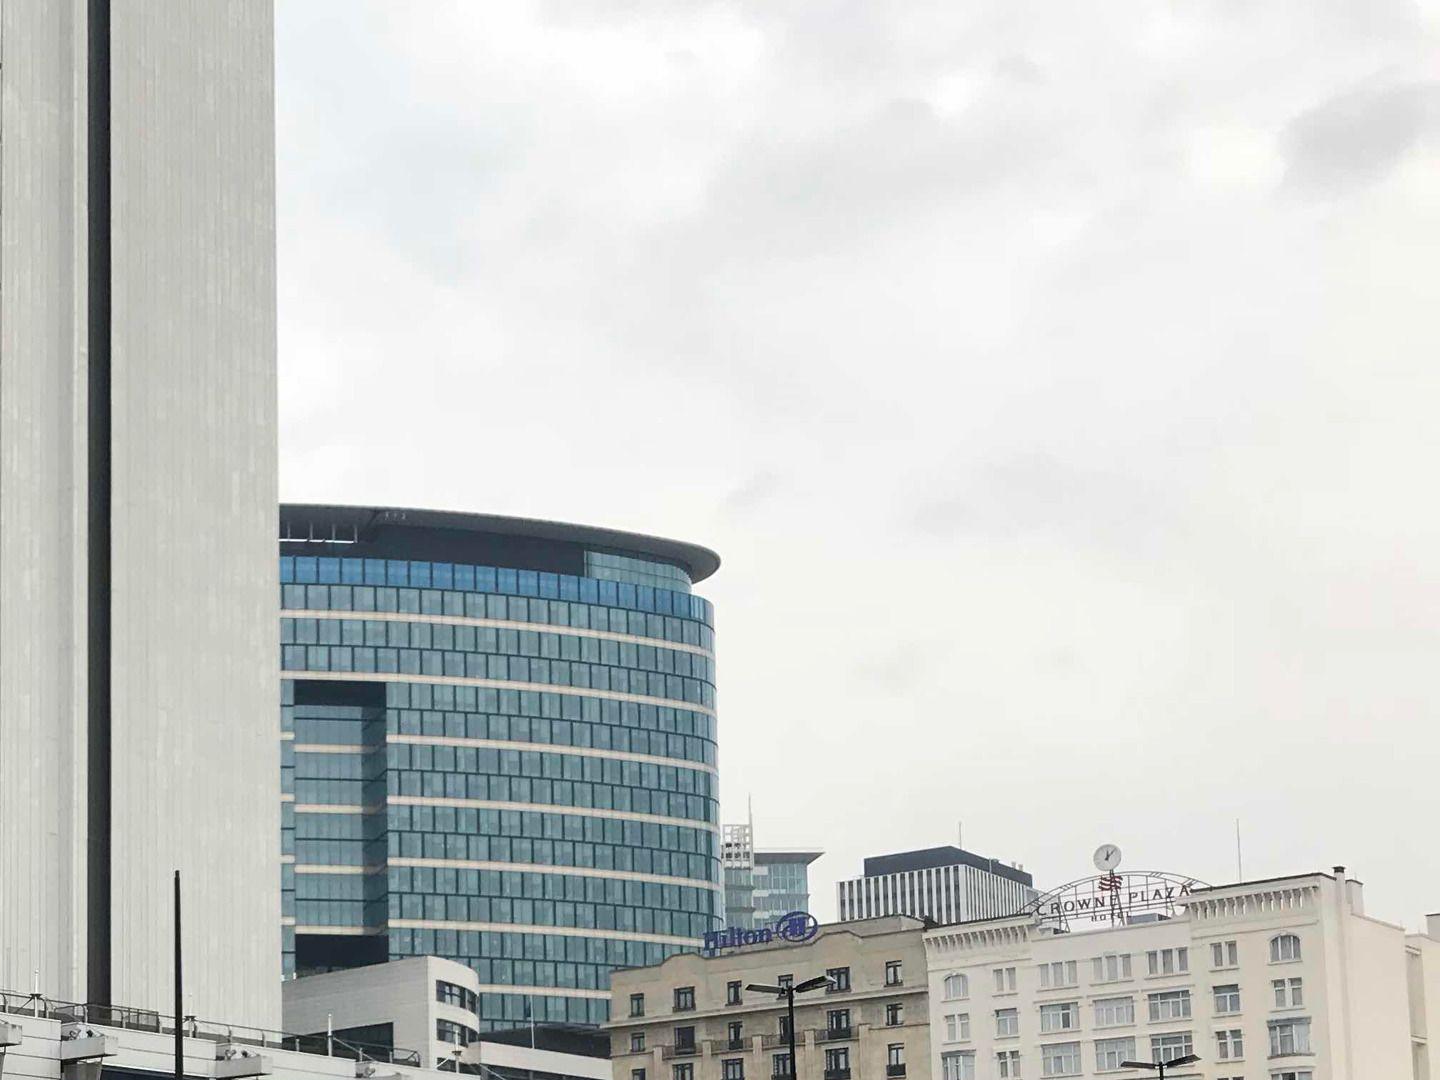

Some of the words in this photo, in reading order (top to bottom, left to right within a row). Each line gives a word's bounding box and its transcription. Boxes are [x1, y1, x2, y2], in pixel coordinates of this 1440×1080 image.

[1036, 895, 1118, 916] CROWNE
[1129, 885, 1192, 903] PLAZA
[704, 926, 773, 957] Hilton
